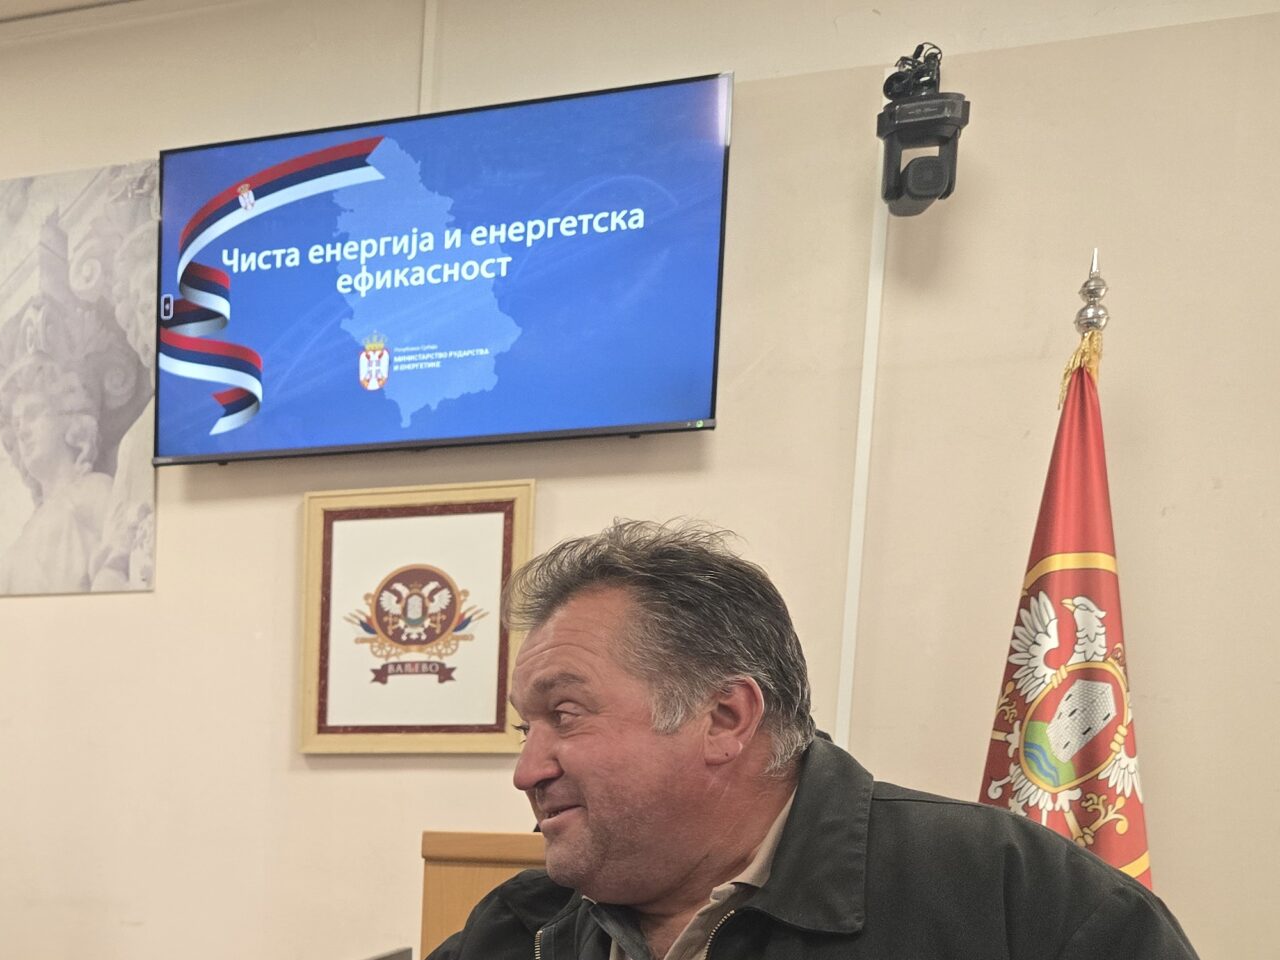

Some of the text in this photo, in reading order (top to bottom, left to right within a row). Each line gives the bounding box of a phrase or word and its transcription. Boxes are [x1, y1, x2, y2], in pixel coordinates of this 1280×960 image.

[222, 207, 645, 274] Чиста енергија и енергетска
[336, 255, 512, 298] ефикасност
